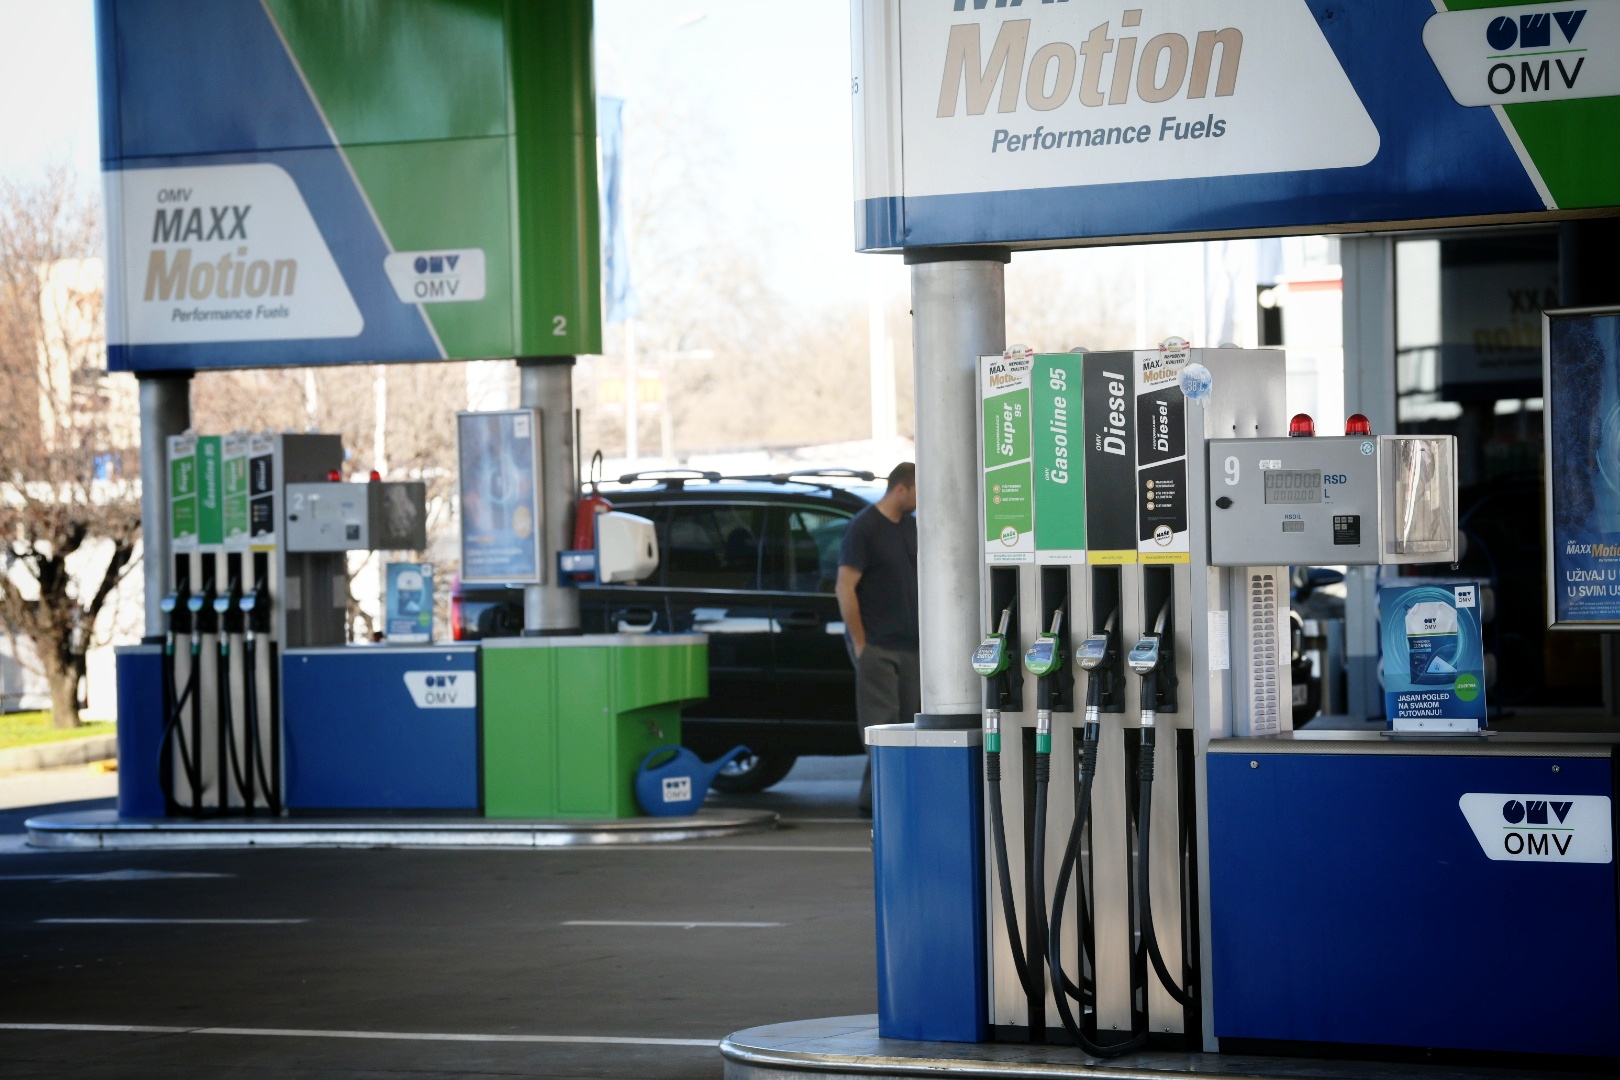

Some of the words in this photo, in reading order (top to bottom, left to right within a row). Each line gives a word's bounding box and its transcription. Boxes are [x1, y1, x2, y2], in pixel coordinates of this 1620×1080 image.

[936, 9, 1244, 118] Motion
[1487, 57, 1585, 95] OMV
[991, 120, 1151, 154] Performance
[1158, 113, 1227, 143] Fuels
[157, 188, 193, 203] OMV
[152, 204, 252, 244] MAXX
[143, 246, 298, 302] Motion
[413, 280, 461, 299] OMV
[172, 305, 251, 323] Performance
[255, 304, 290, 319] Fuels
[551, 315, 567, 336] 2
[989, 364, 1006, 375] MAX
[1143, 359, 1162, 371] MAX
[1050, 367, 1068, 392] 95
[1014, 403, 1022, 417] 95
[1102, 370, 1126, 456] Diesel
[1001, 402, 1015, 457] Super
[1156, 400, 1169, 452] Diesel
[1050, 396, 1069, 485] Gasoline
[1224, 456, 1241, 486] 9
[1324, 474, 1347, 485] RSD
[1324, 488, 1331, 499] L
[1566, 544, 1592, 555] MAXX
[1566, 568, 1605, 582] UŽIVAJ
[1608, 570, 1616, 581] U
[1567, 586, 1576, 597] U
[1579, 585, 1606, 597] SVIM
[425, 692, 458, 705] OMV
[1397, 694, 1421, 702] JASAN
[1421, 693, 1450, 701] POGLED
[1398, 709, 1443, 717] PUTOVANJU!
[1504, 832, 1573, 856] OMV
